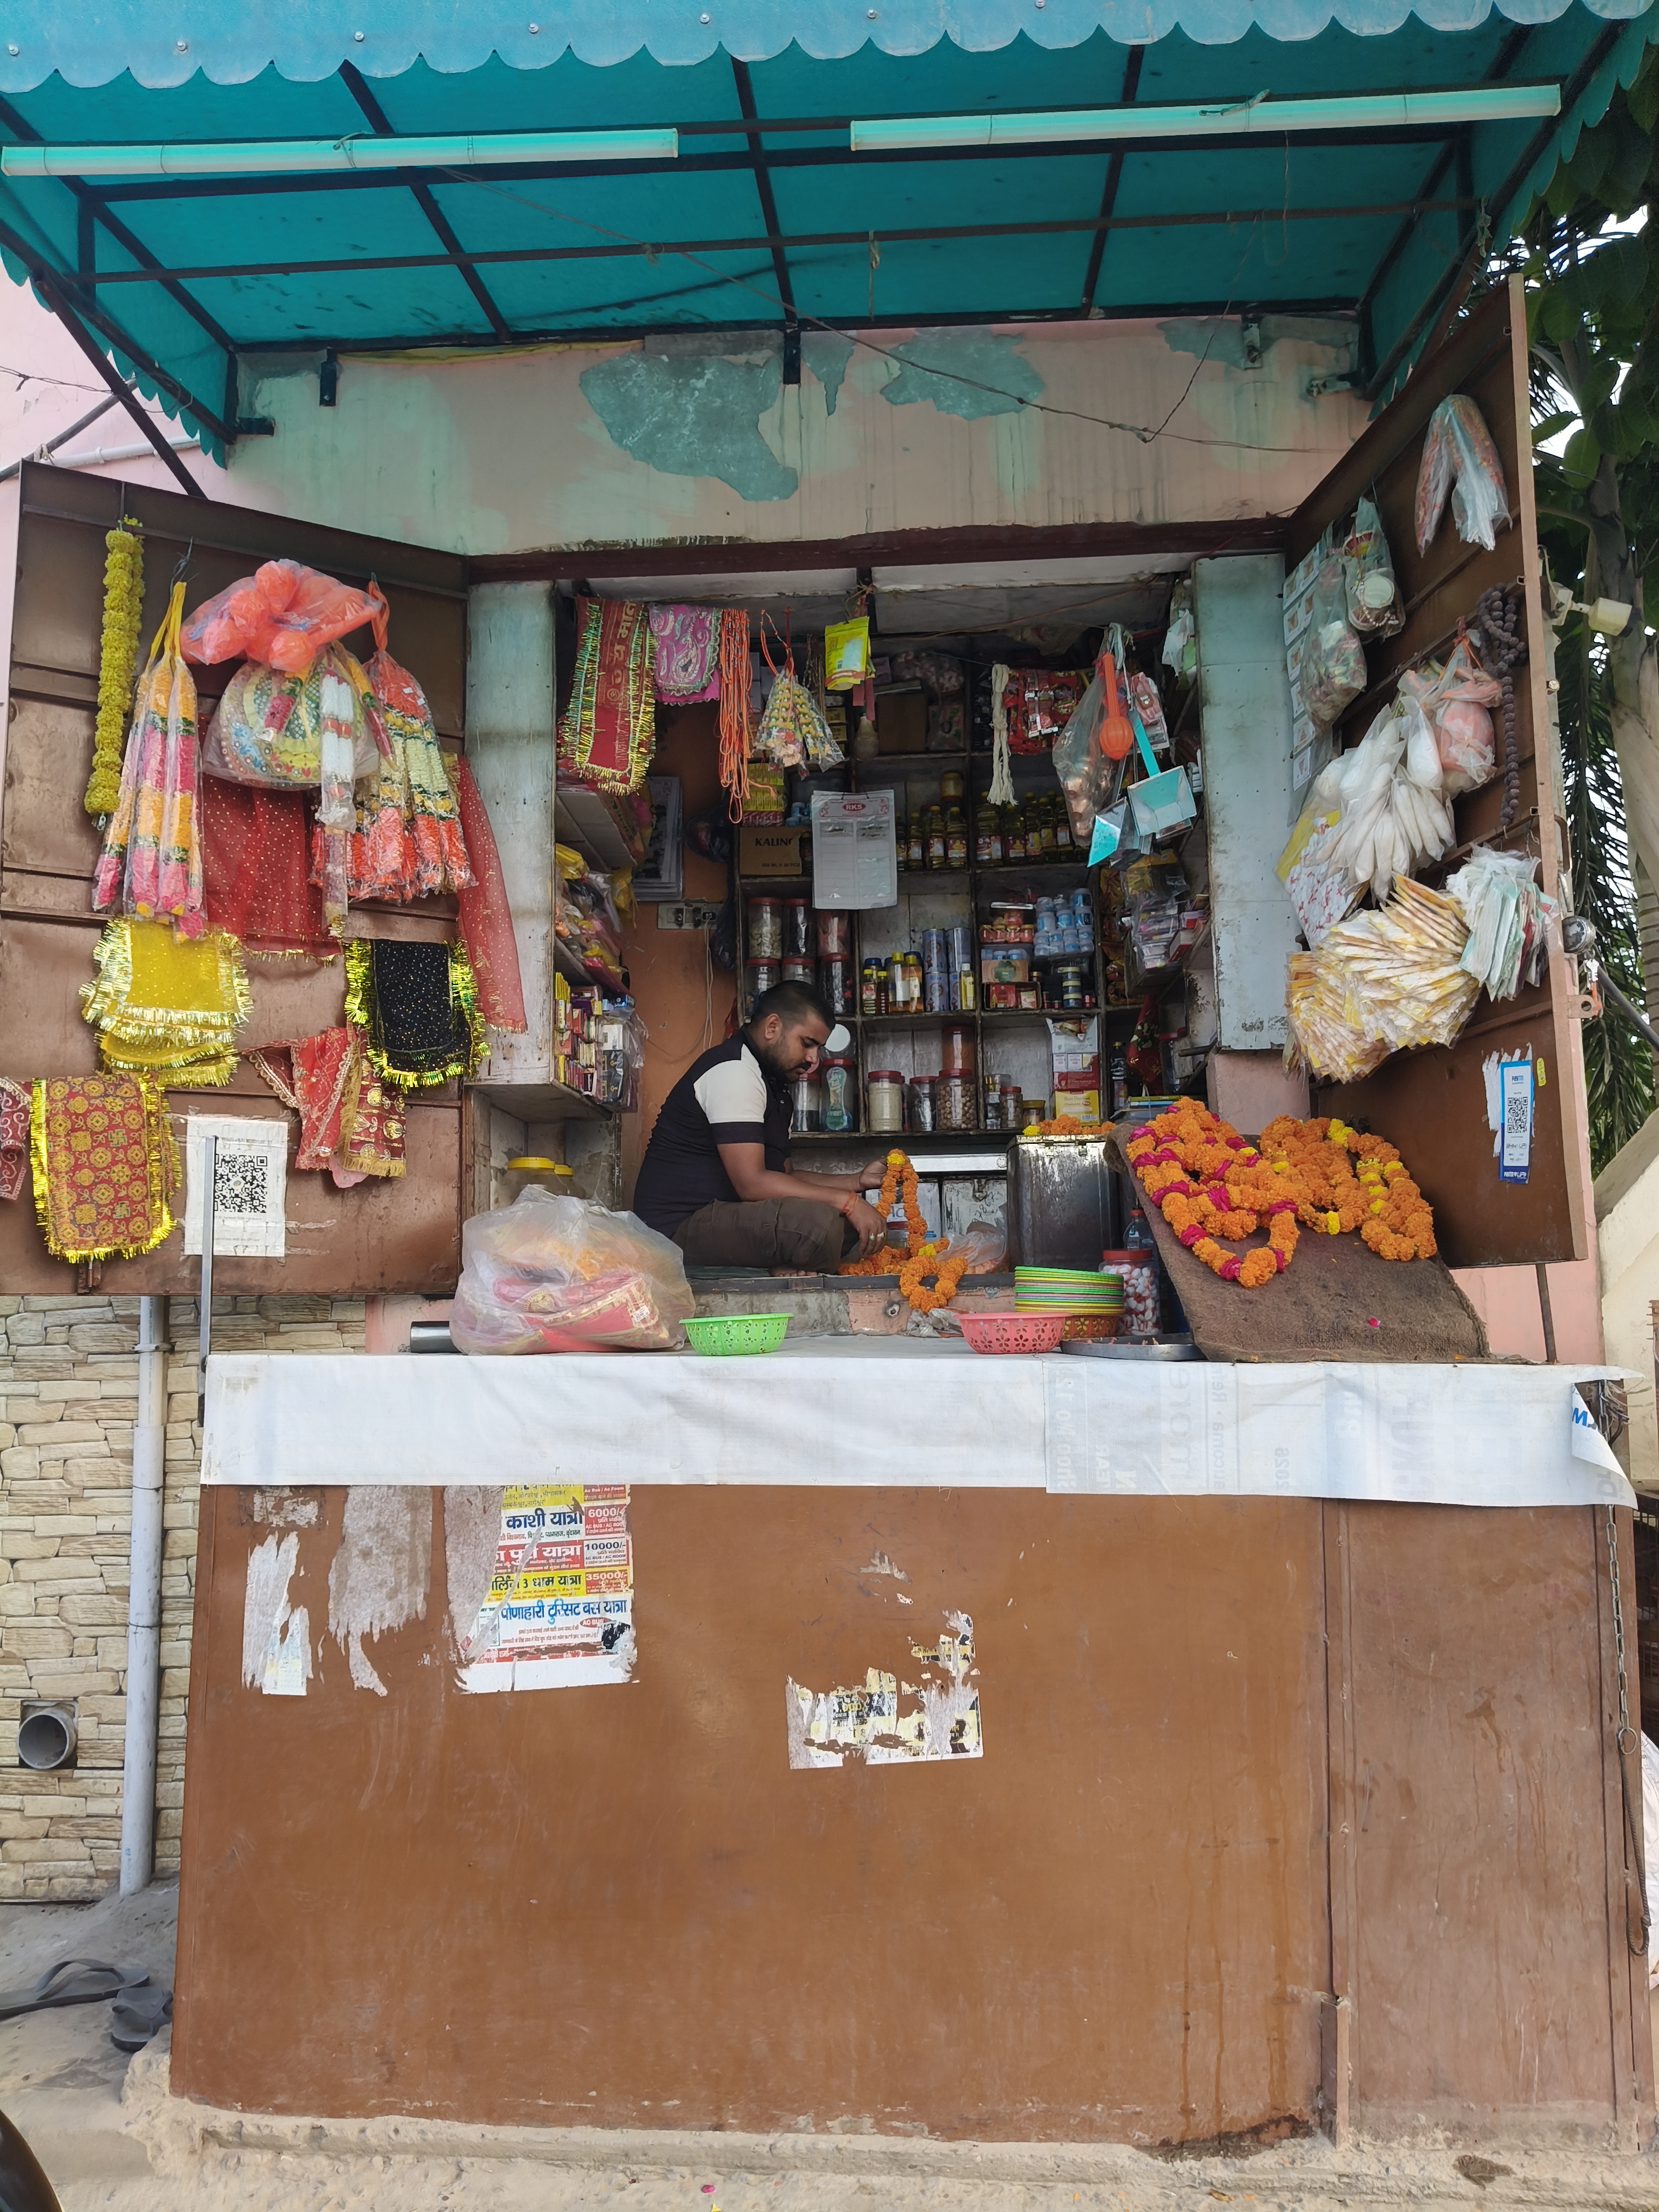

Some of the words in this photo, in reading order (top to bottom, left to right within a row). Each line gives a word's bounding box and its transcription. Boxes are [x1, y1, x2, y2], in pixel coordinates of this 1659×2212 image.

[505, 1507, 547, 1529] काशी
[549, 1511, 583, 1526] यात्रा
[541, 1545, 582, 1557] यात्रा
[584, 1541, 626, 1550] 10000/-
[557, 1574, 582, 1586] यात्रा
[585, 1571, 628, 1581] 35000/-
[582, 1601, 601, 1615] बस
[603, 1600, 628, 1614] यात्रा
